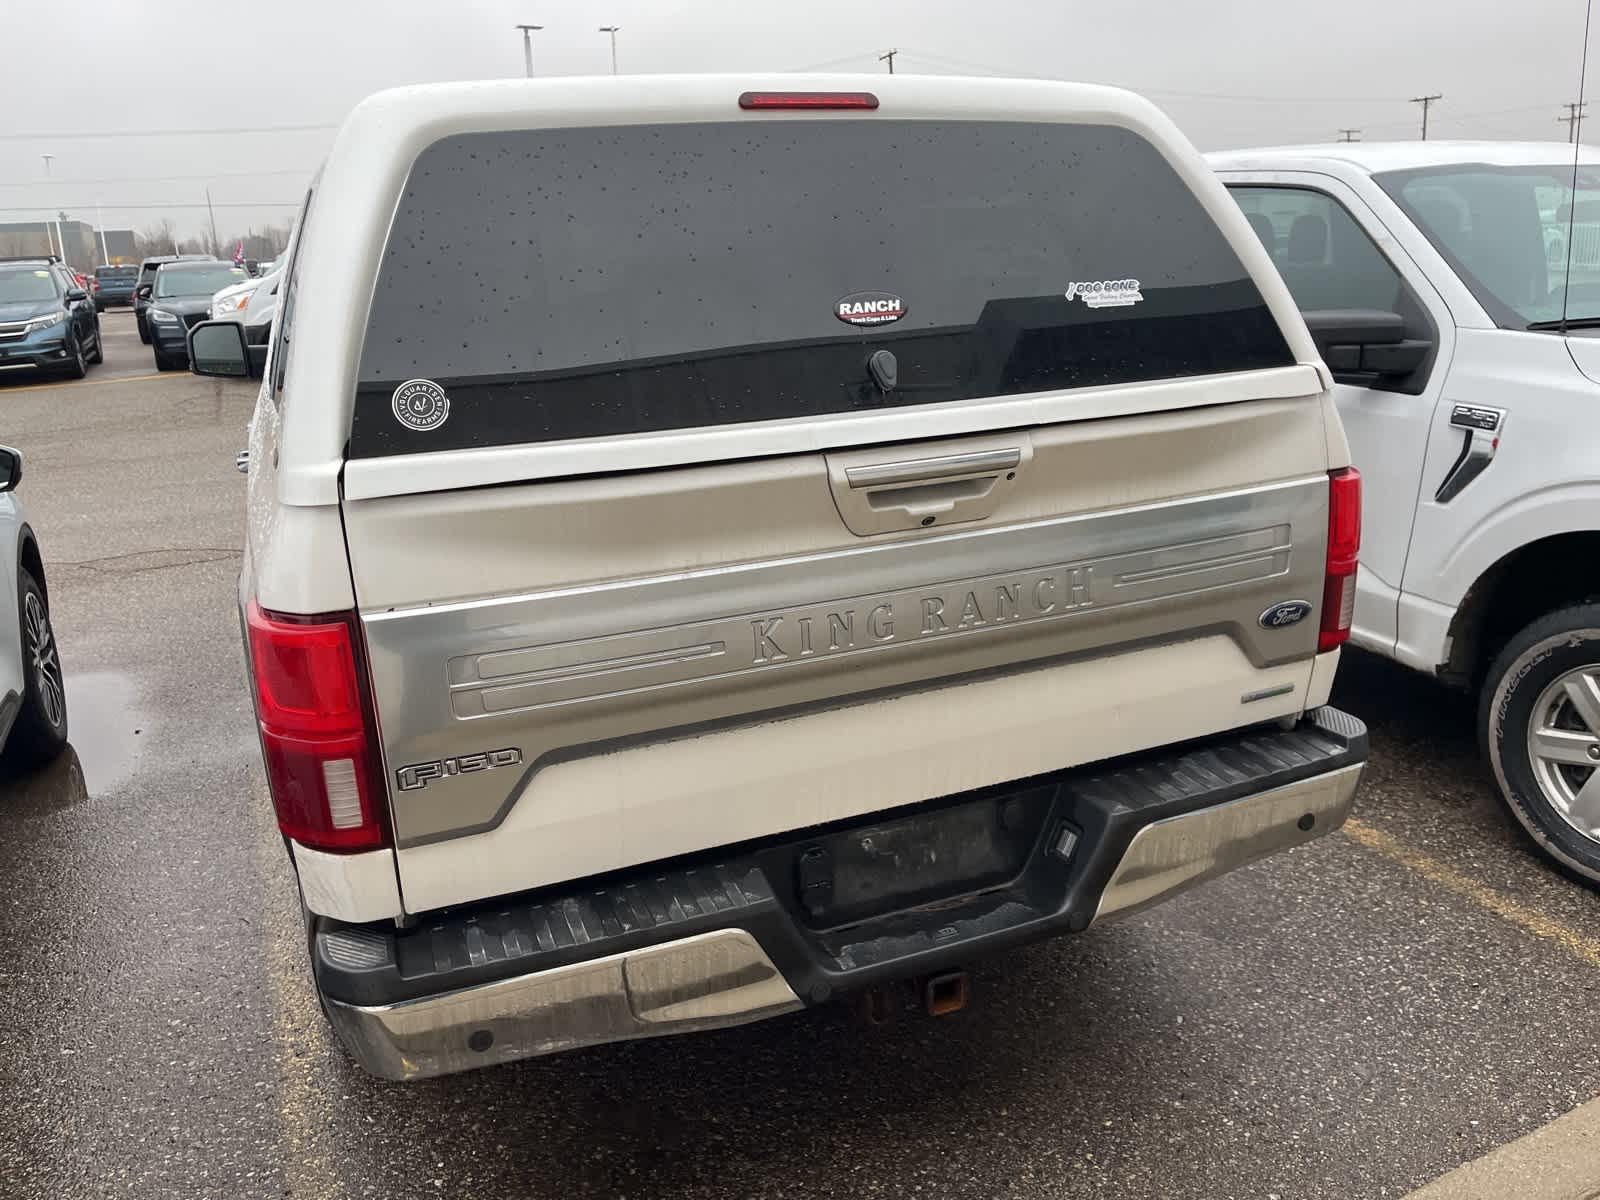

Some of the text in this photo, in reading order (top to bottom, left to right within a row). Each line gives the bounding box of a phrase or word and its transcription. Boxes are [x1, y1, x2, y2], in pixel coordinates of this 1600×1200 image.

[1103, 280, 1138, 292] BONE
[839, 299, 901, 315] RANCH
[403, 410, 442, 425] FIREARMS
[750, 566, 1096, 664] KING RANCH
[1272, 606, 1303, 625] Ford
[395, 746, 523, 793] F150
